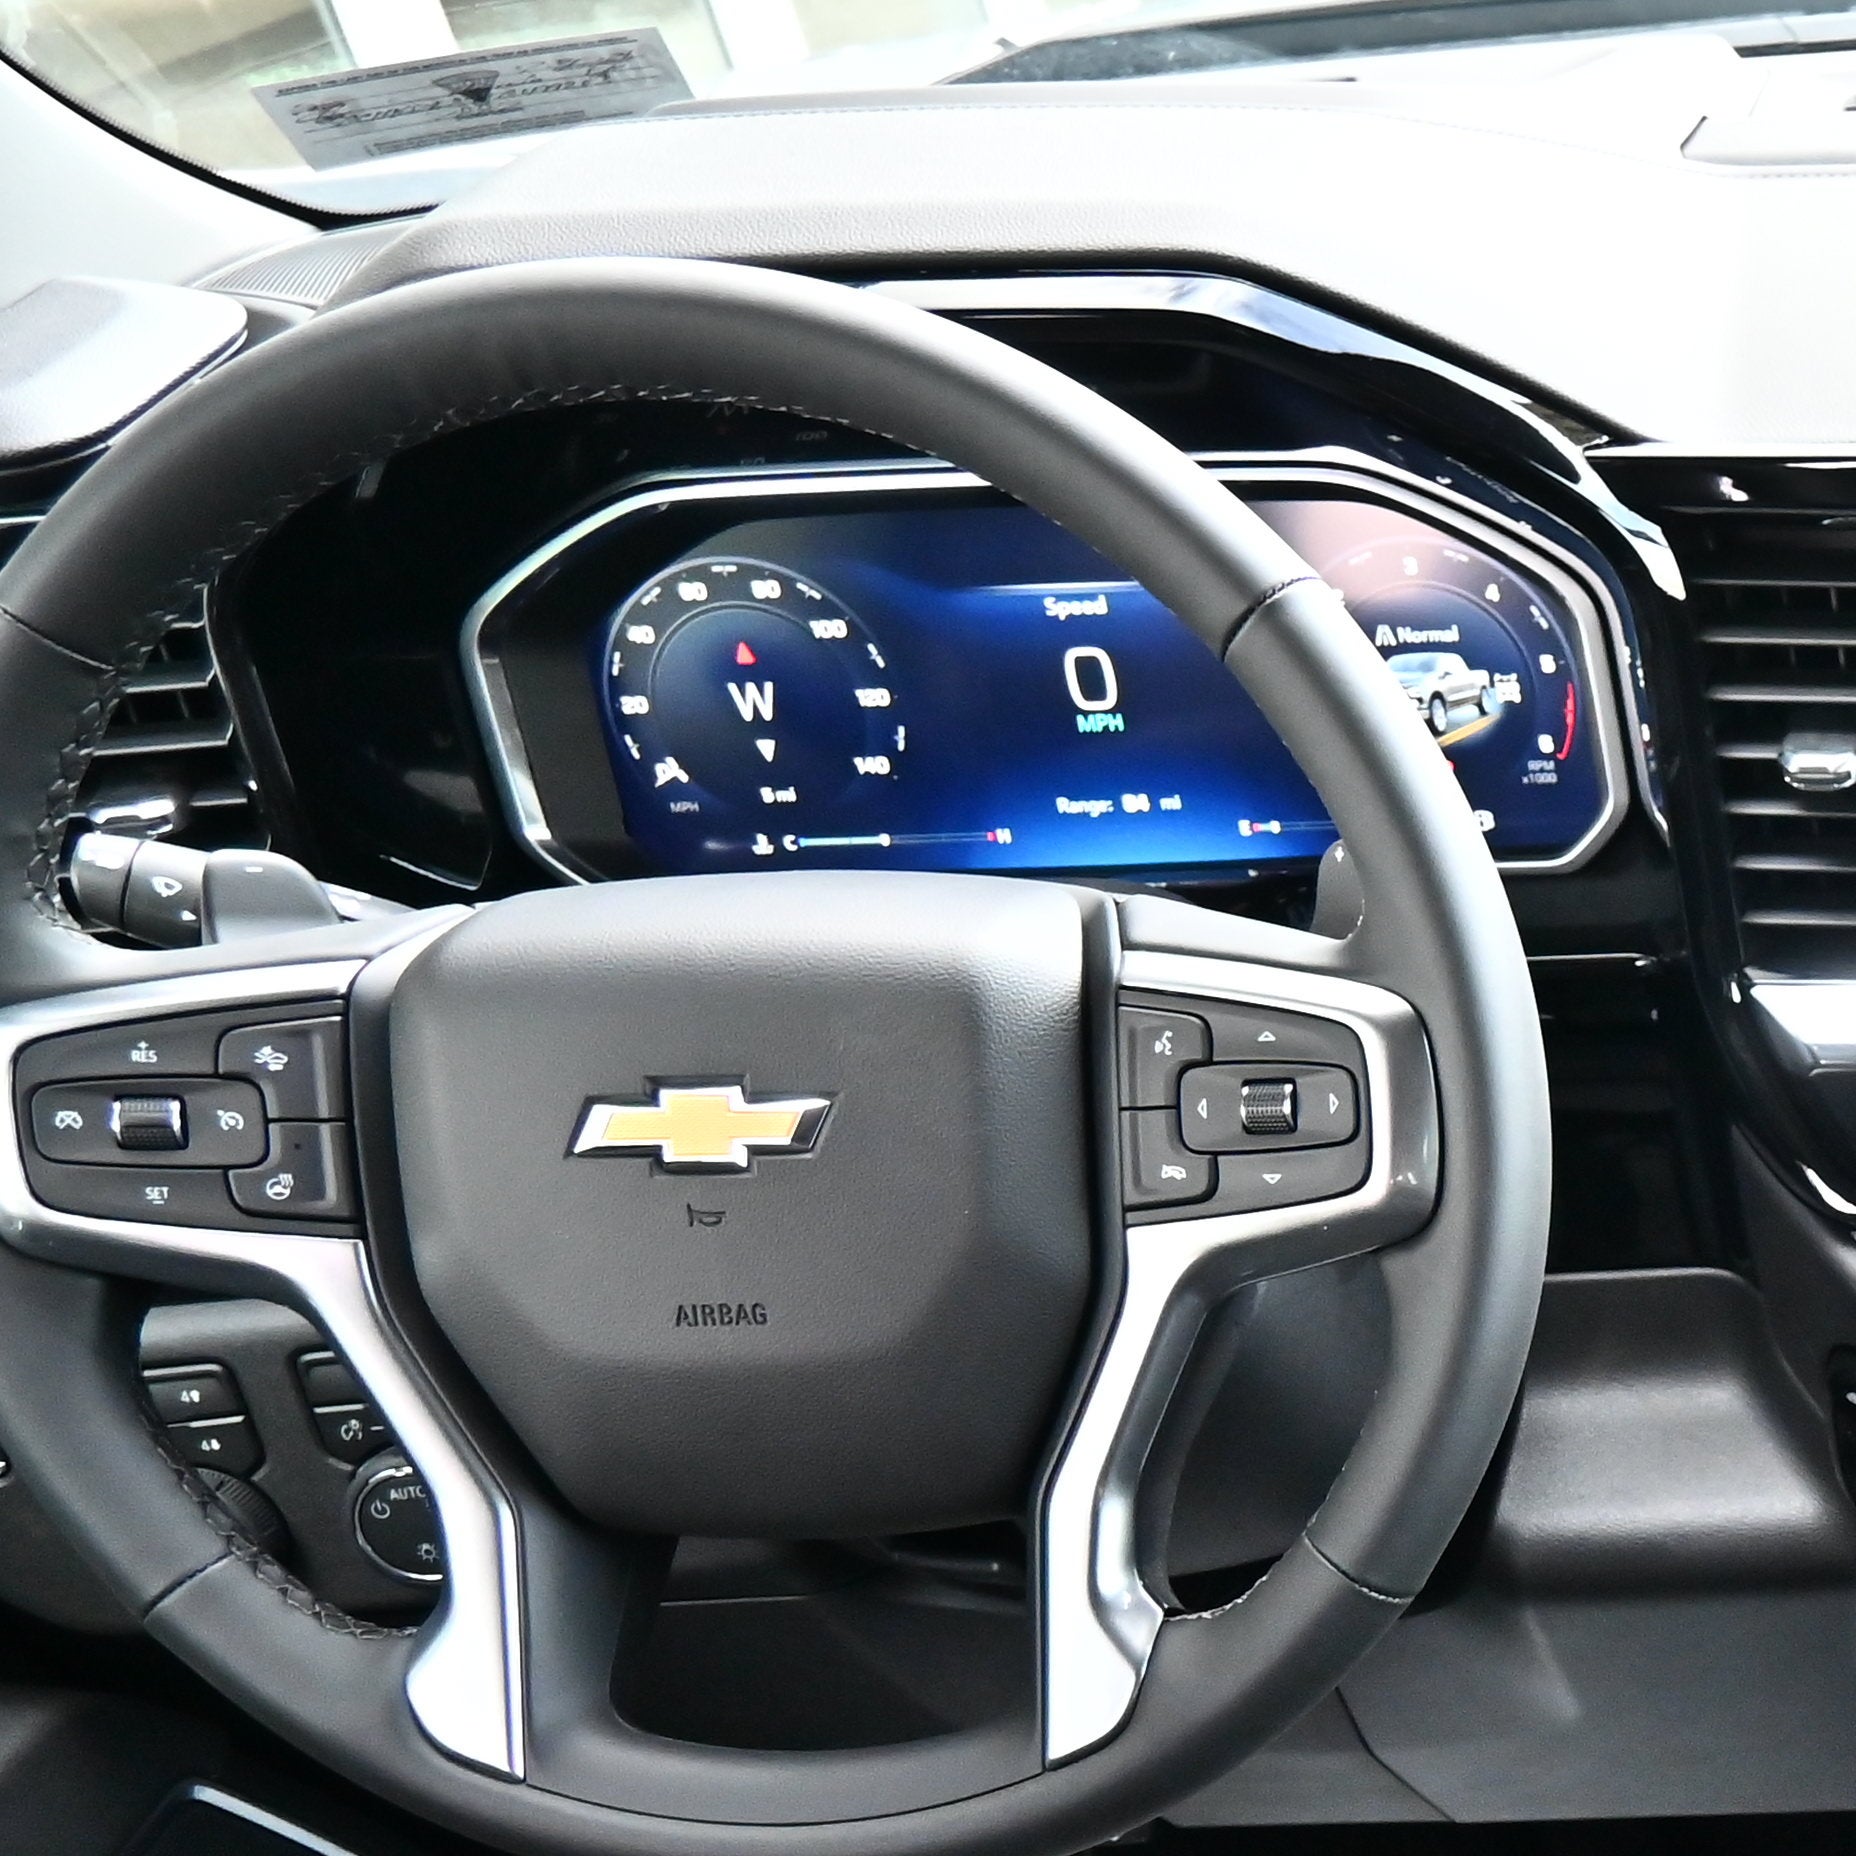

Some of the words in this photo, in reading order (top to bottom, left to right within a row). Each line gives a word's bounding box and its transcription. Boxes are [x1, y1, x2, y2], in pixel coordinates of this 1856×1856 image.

[1043, 594, 1109, 621] Speed
[809, 619, 848, 640] 100
[1396, 624, 1460, 644] Normal
[1063, 646, 1118, 711] 0
[619, 695, 650, 715] 20
[727, 681, 774, 722] W
[854, 688, 891, 707] 120
[1076, 713, 1125, 734] MPH
[853, 756, 891, 776] 140
[1055, 795, 1115, 818] Range:
[1159, 794, 1183, 811] mi
[131, 1048, 158, 1064] RES
[145, 1185, 169, 1200] SET
[675, 1304, 768, 1328] AIRBAG
